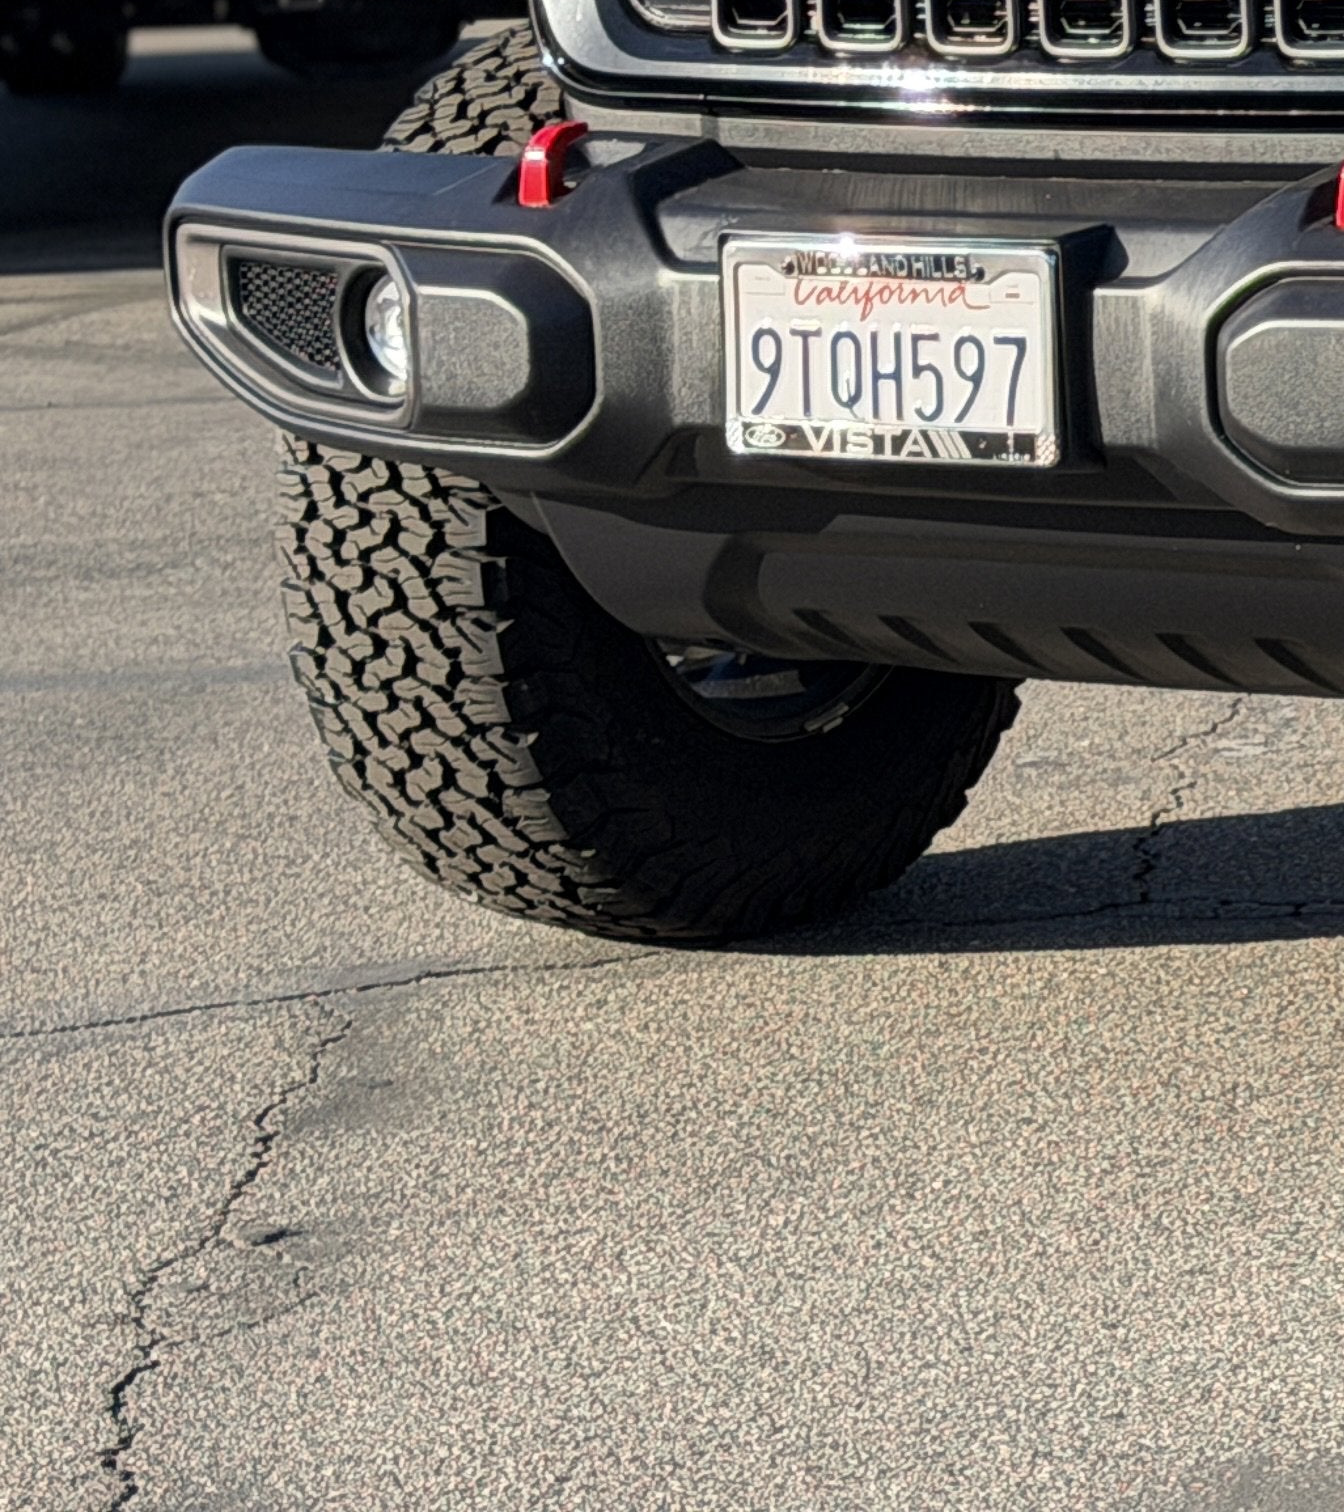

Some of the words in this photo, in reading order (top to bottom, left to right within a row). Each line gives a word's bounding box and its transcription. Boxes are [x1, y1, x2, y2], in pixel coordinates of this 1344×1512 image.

[800, 250, 908, 278] WOOAND
[911, 254, 967, 279] HILLS
[794, 278, 990, 321] California
[751, 322, 1028, 427] 9TQH597
[801, 423, 932, 459] VISTA
